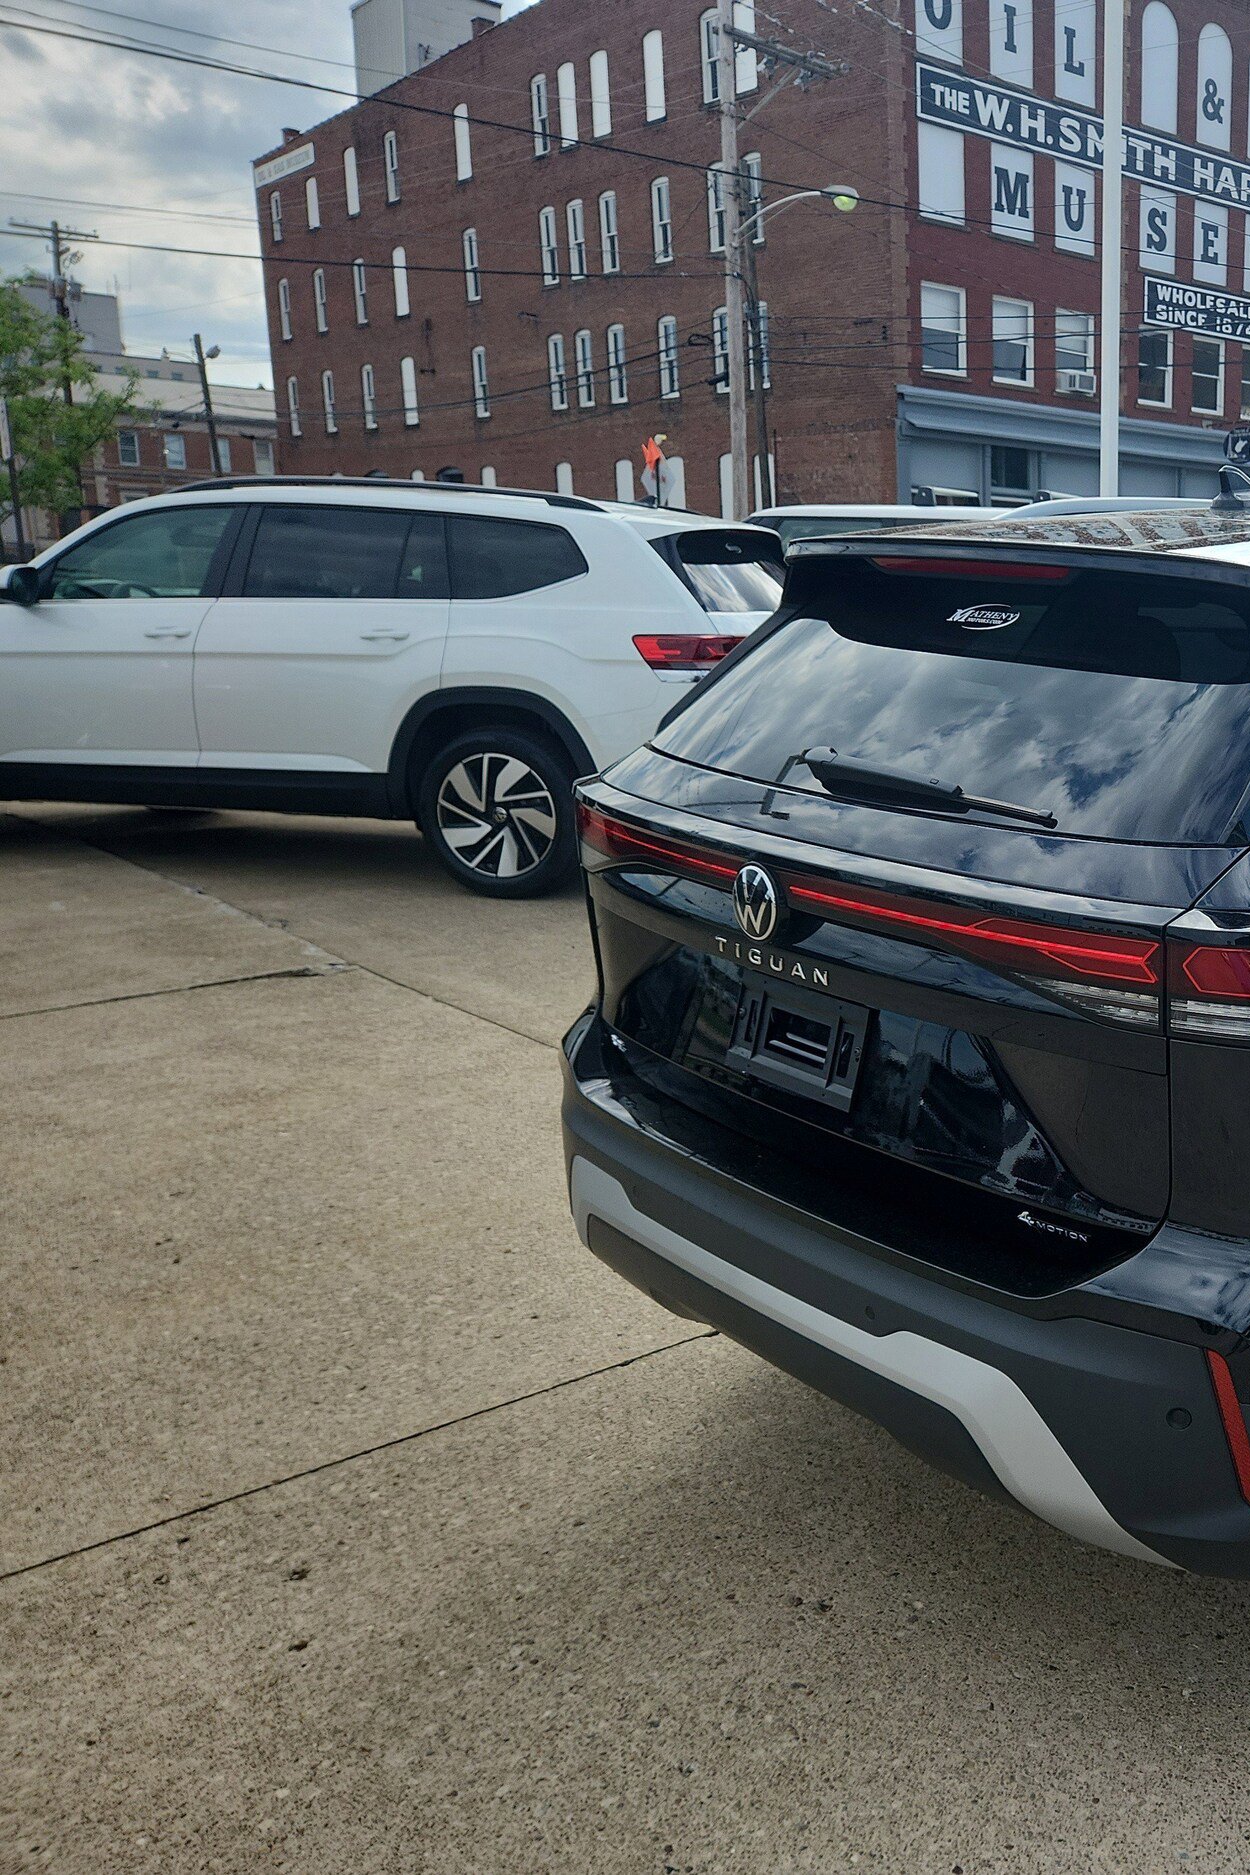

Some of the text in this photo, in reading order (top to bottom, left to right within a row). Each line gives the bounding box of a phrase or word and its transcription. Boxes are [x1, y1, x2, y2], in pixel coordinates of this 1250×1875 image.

[930, 83, 969, 115] THE
[1202, 78, 1224, 123] &
[1156, 304, 1207, 330] SINCE
[946, 608, 1018, 622] MATHENY
[714, 935, 829, 987] TIGUAN
